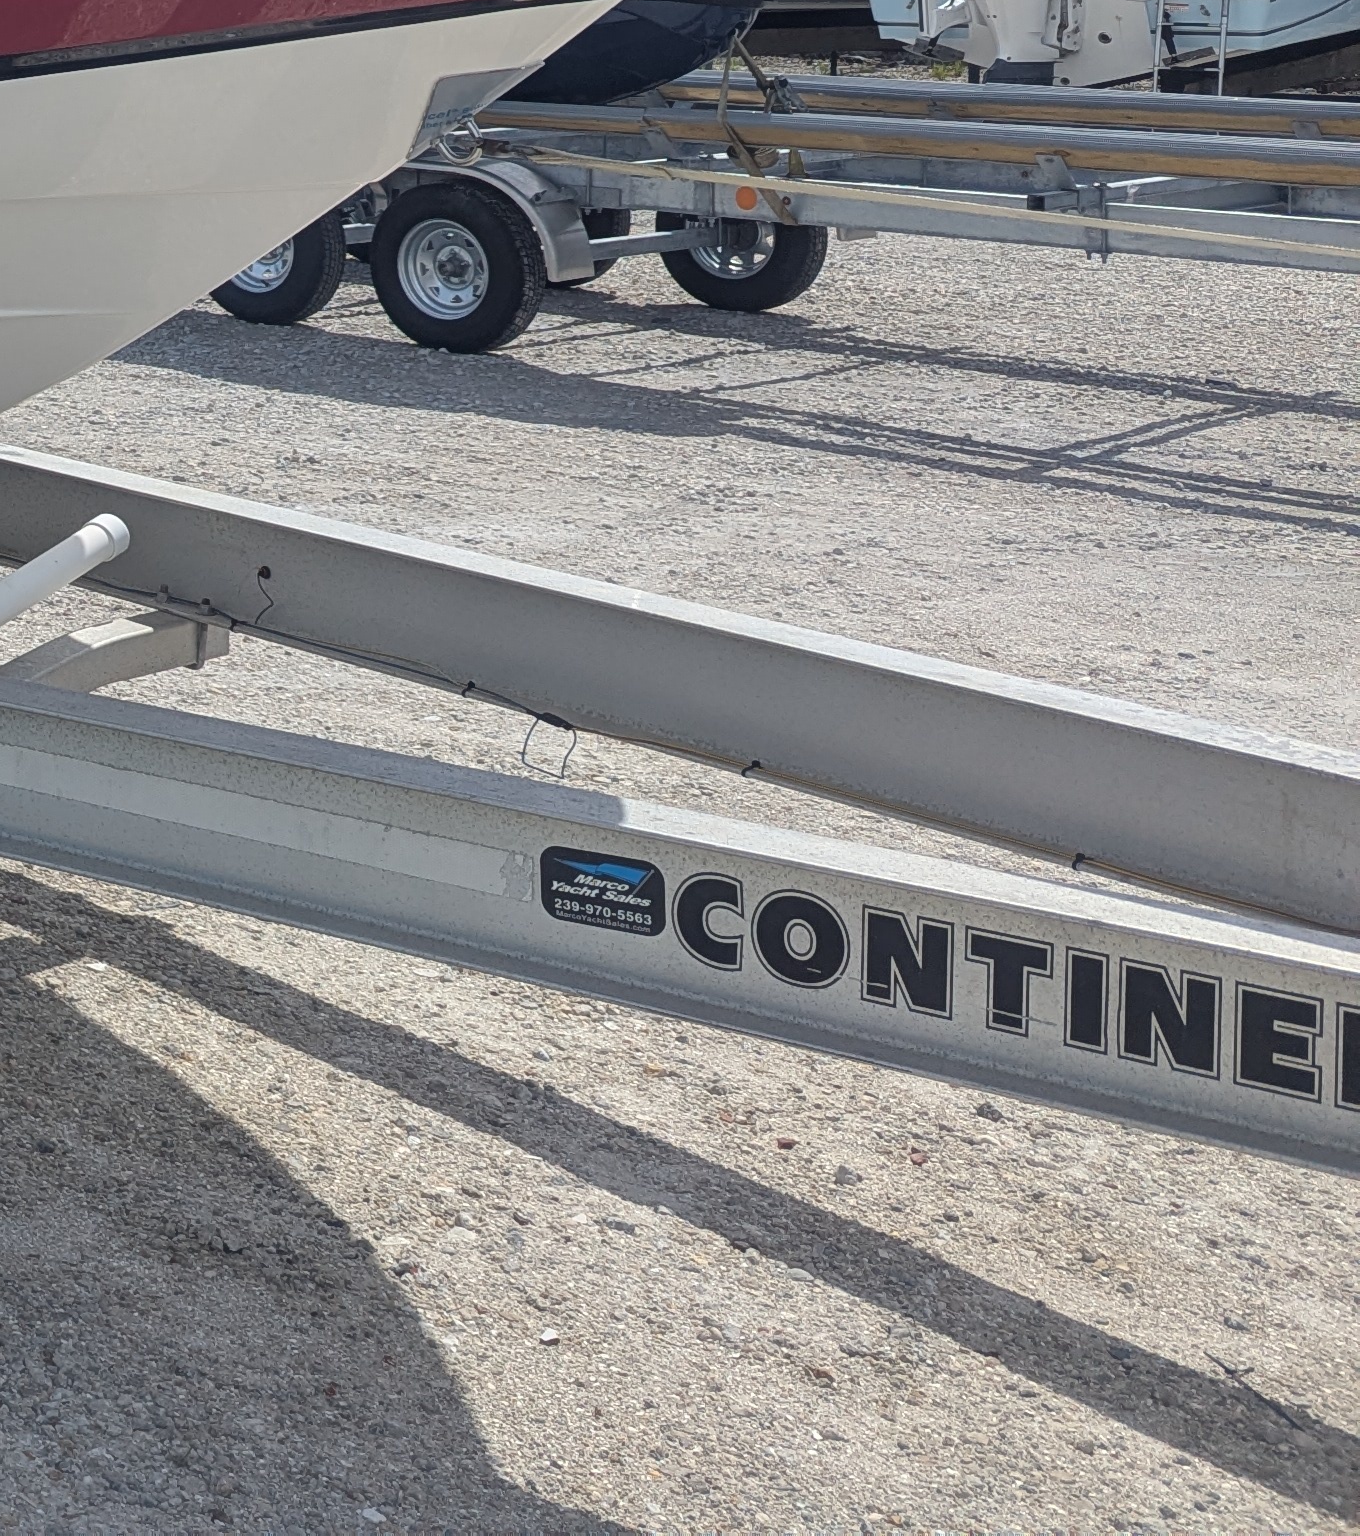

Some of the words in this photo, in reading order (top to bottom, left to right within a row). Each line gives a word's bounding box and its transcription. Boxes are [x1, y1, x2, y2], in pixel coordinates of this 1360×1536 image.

[551, 880, 600, 898] Yacht
[602, 890, 652, 907] Sales
[574, 873, 630, 892] Marco
[554, 898, 653, 926] 239-970-5563
[672, 872, 1360, 1113] CONTINE
